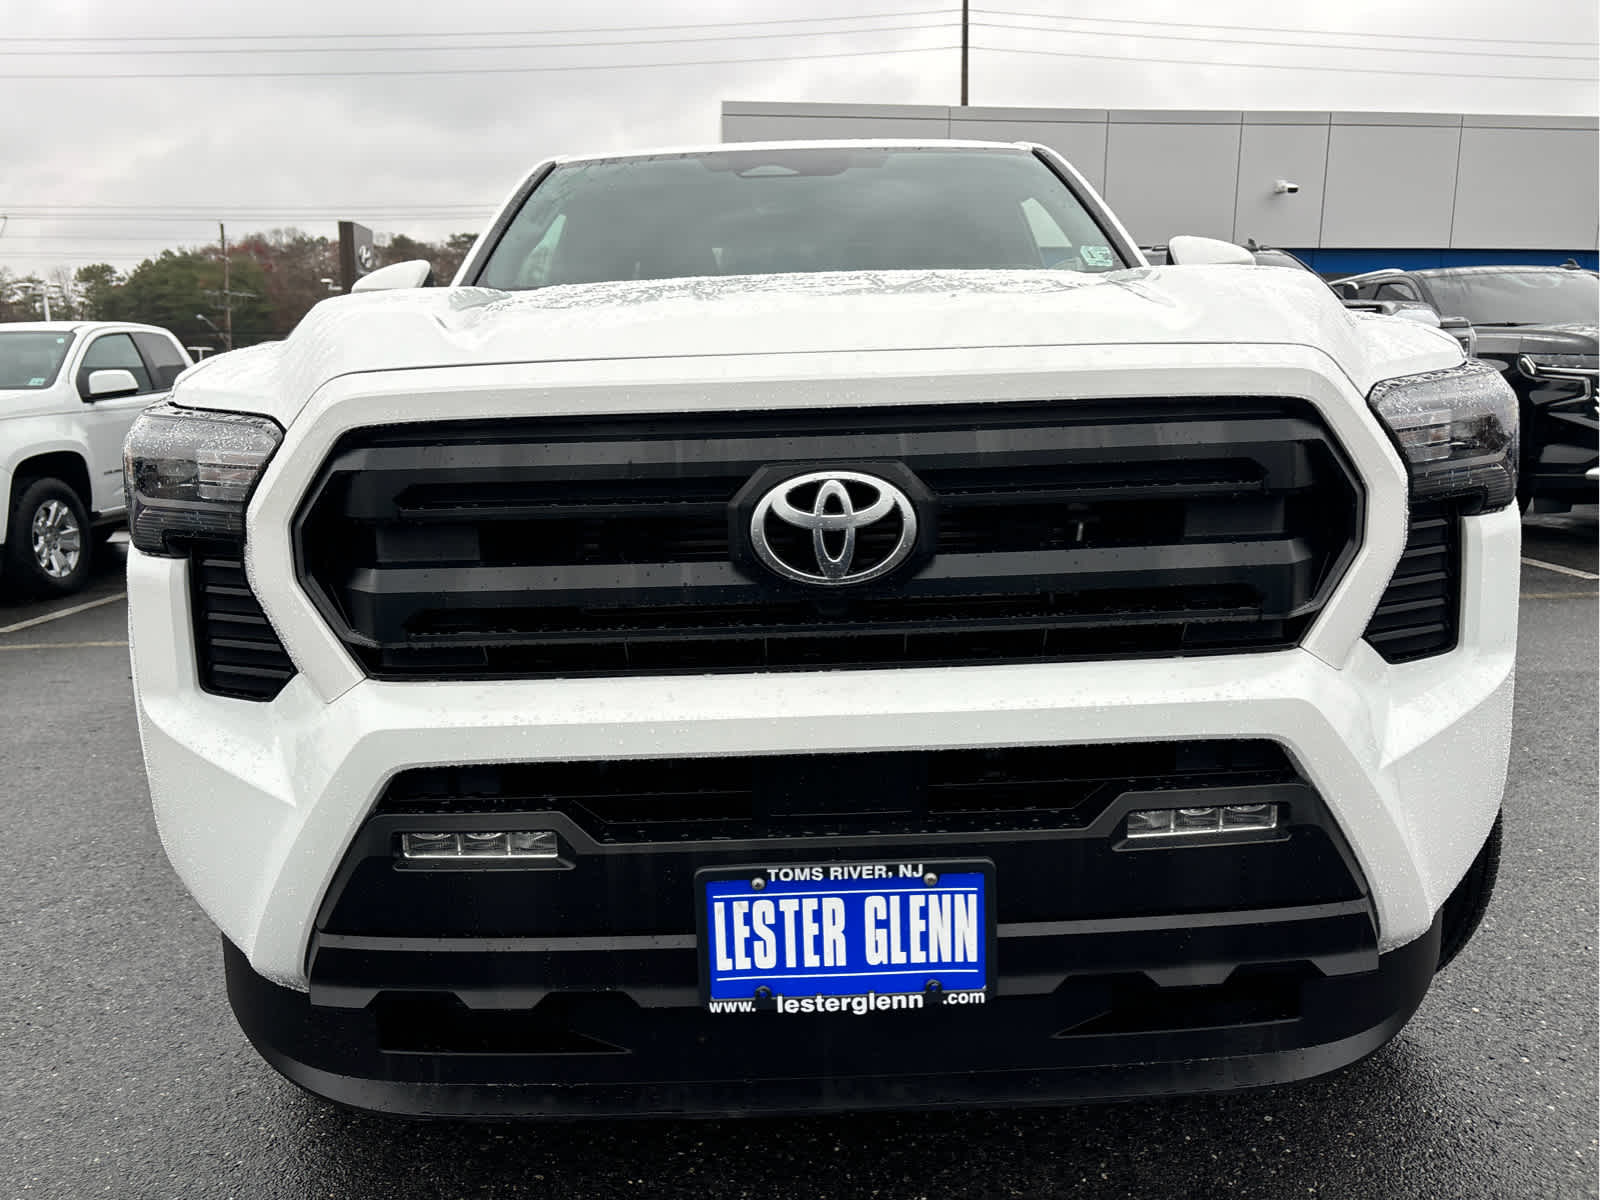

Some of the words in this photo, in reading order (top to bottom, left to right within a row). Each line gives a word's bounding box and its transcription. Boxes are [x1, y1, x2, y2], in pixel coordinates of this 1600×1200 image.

[767, 867, 824, 882] TOMS
[830, 865, 893, 880] RIVER,
[899, 864, 923, 878] NJ
[714, 897, 847, 971] LESTER
[864, 894, 978, 966] GLENN
[709, 1001, 757, 1013] www.
[777, 993, 924, 1015] lesterglenn
[943, 991, 985, 1005] .com
